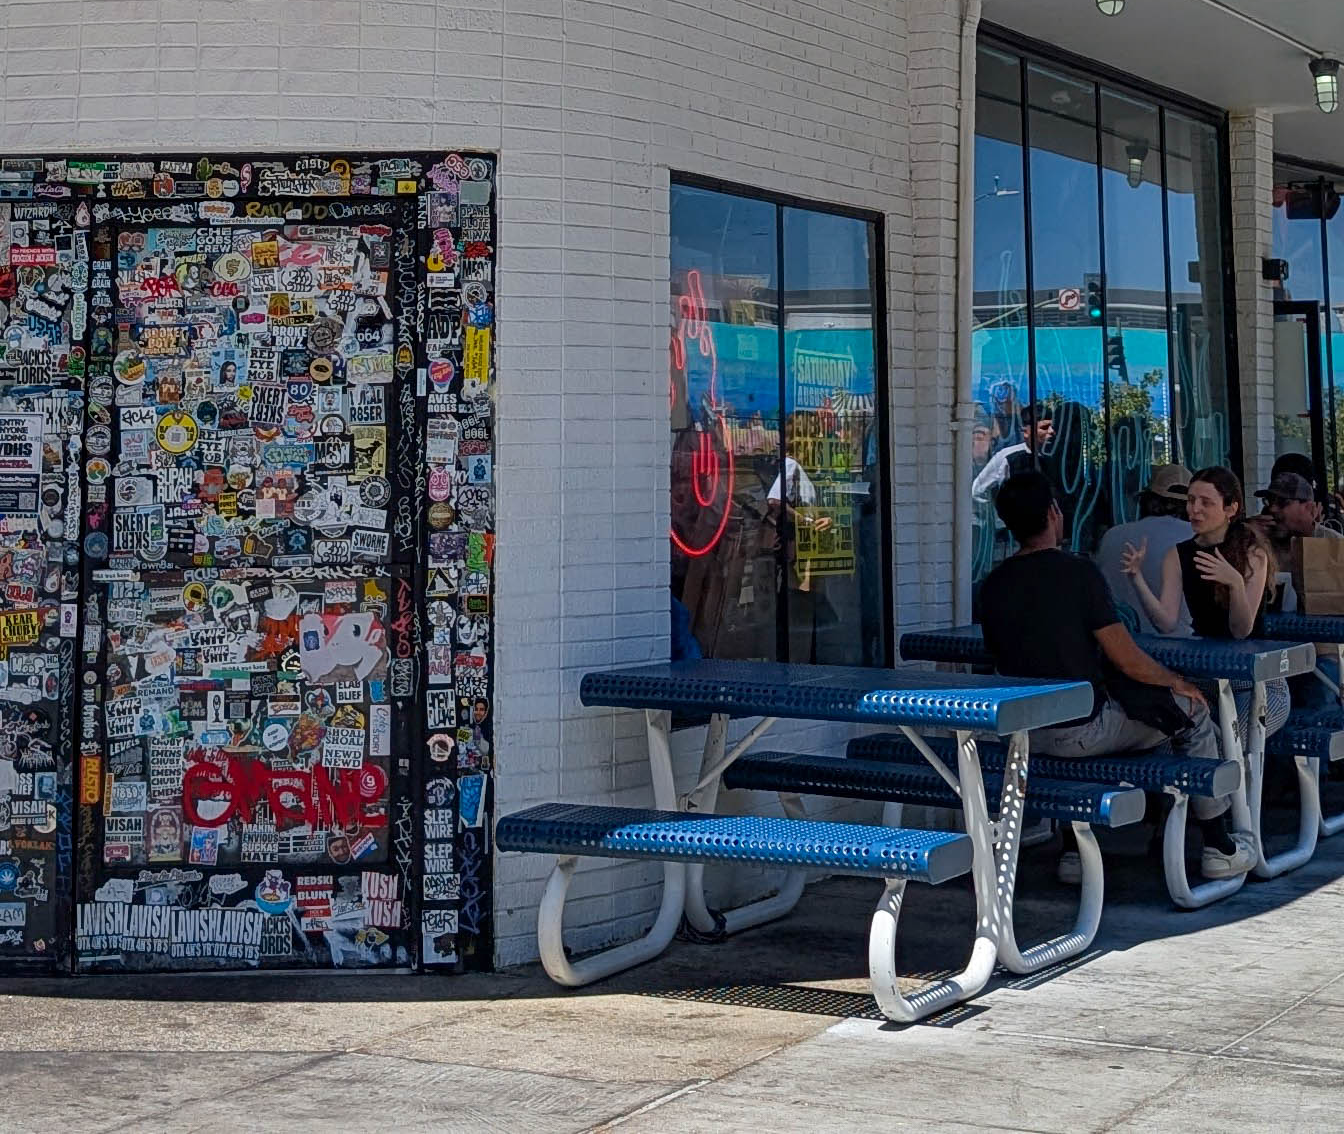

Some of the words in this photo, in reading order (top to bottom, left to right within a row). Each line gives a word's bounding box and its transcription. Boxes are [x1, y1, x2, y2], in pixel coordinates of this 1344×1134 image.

[196, 227, 232, 236] CHE
[196, 236, 232, 245] GOBS
[196, 244, 232, 253] CREW
[272, 326, 308, 336] BROKE
[275, 336, 304, 346] BOYZ
[248, 349, 275, 359] RED
[248, 360, 275, 370] EYE
[290, 384, 309, 395] 80
[428, 394, 456, 404] AVES
[428, 404, 456, 413] ROBES
[0, 418, 26, 426] ENTRY
[157, 467, 193, 485] SUPAH
[115, 513, 150, 532] SKERT
[2, 625, 37, 638] CHUBY
[191, 628, 226, 639] TANK
[191, 635, 224, 646] SHIT
[202, 645, 229, 654] TANK
[202, 652, 229, 664] SHIT
[107, 698, 142, 711] TANK
[109, 706, 141, 718] SHIT
[108, 716, 134, 726] TANK
[109, 724, 134, 736] SHIT
[325, 736, 364, 746] SHOAL
[324, 749, 362, 759] NEWD
[324, 757, 361, 768] NEWD
[11, 800, 46, 814] VISAH
[106, 819, 142, 832] VISAH
[424, 824, 454, 838] WIRE
[242, 833, 279, 843] ENVIOUS
[242, 842, 279, 852] SUCKAS
[241, 852, 279, 862] HATE
[424, 858, 454, 872] WIRE
[297, 890, 333, 901] BLUNT
[76, 903, 123, 937] LAVISH
[124, 904, 171, 938] LAVISH
[171, 909, 216, 944] LAVISH
[215, 911, 264, 946] LAVISH
